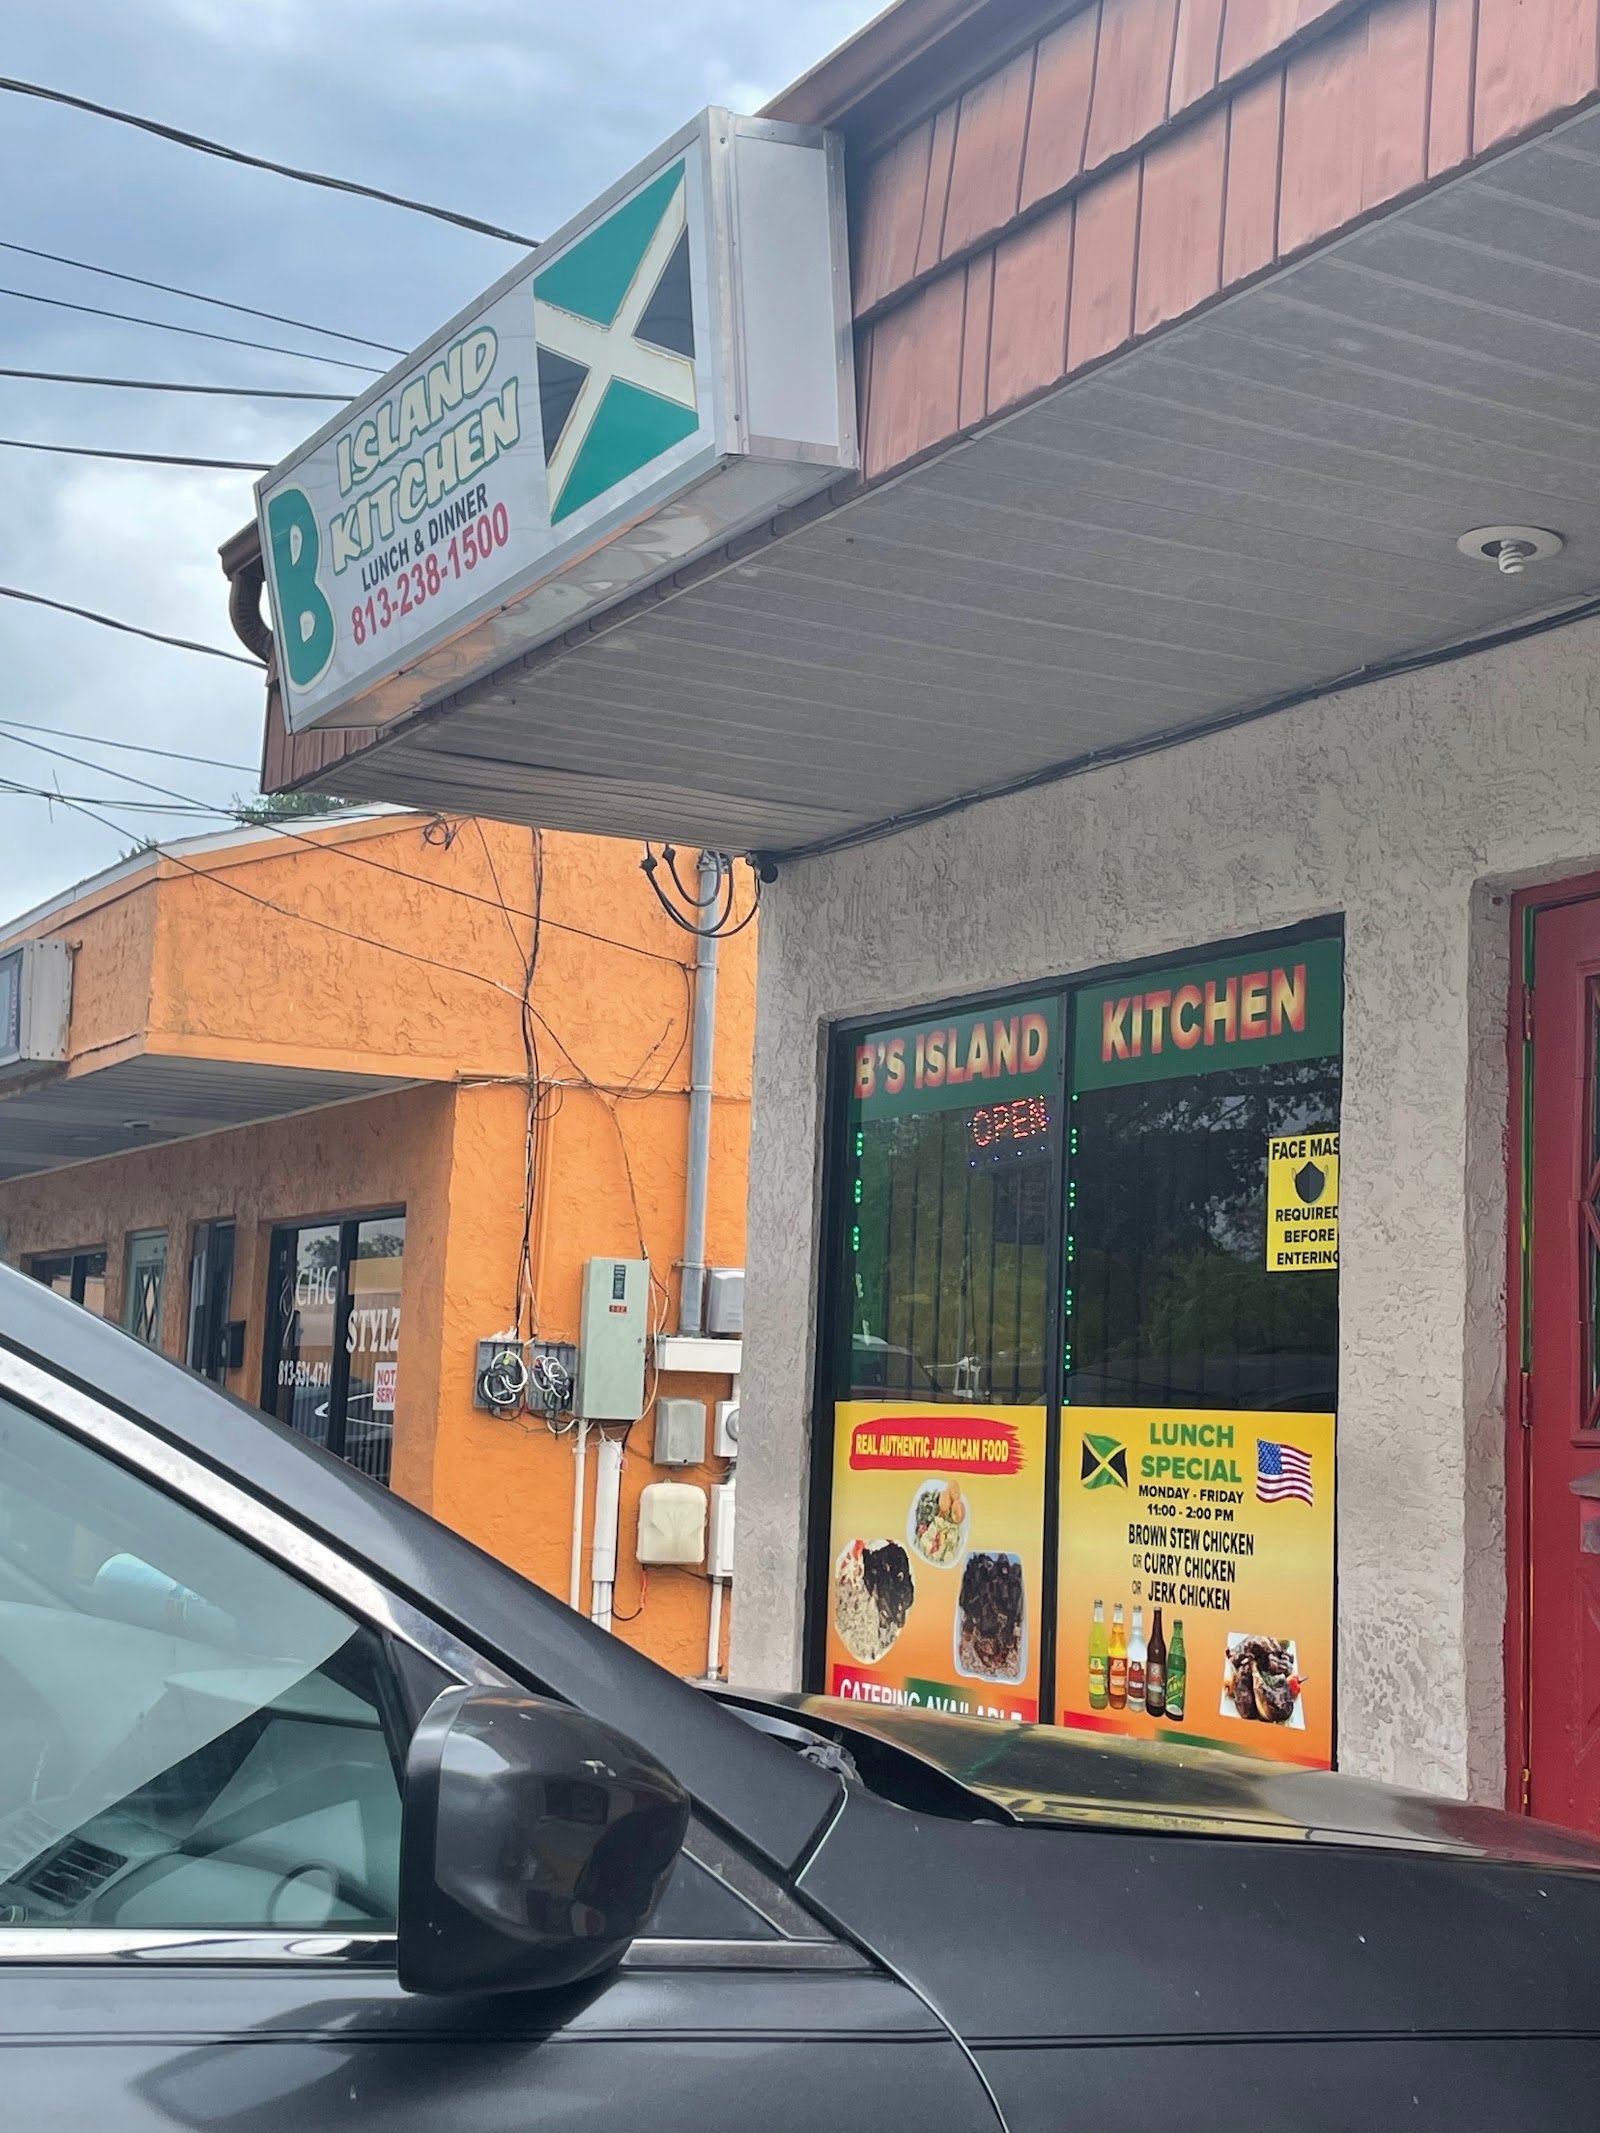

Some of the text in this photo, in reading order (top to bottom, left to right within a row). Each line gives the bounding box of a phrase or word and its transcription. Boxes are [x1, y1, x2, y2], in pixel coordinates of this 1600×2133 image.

[335, 326, 498, 497] ISLAND
[329, 376, 520, 575] KITCHEN
[361, 483, 489, 592] LUNCH & DINNER
[267, 482, 336, 694] B
[351, 502, 510, 646] 813-238-1500
[854, 963, 1307, 1098] B'S ISLAND KITCHEN
[972, 1096, 1049, 1147] OPEN
[1272, 1136, 1339, 1160] FACE MAS
[1284, 1228, 1335, 1243] BEFORE
[295, 1265, 338, 1305] CHIC
[346, 1307, 400, 1353] STYLZ
[855, 1434, 1009, 1463] REAL AUTHENTIC JAMAICAN FOOD
[1149, 1422, 1234, 1448] LUNCH
[1140, 1455, 1242, 1483] SPECIAL
[1138, 1485, 1190, 1500] MONDAY
[1200, 1489, 1244, 1504] FRIDAY
[1147, 1503, 1176, 1517] 11:00
[1185, 1506, 1212, 1520] 2:00
[1214, 1509, 1234, 1522] PM
[1128, 1523, 1254, 1556] BROWN STEW CHICKEN
[1132, 1552, 1236, 1583] OR CURRY CHICKEN
[1131, 1580, 1230, 1611] OR JERK CHICKEN
